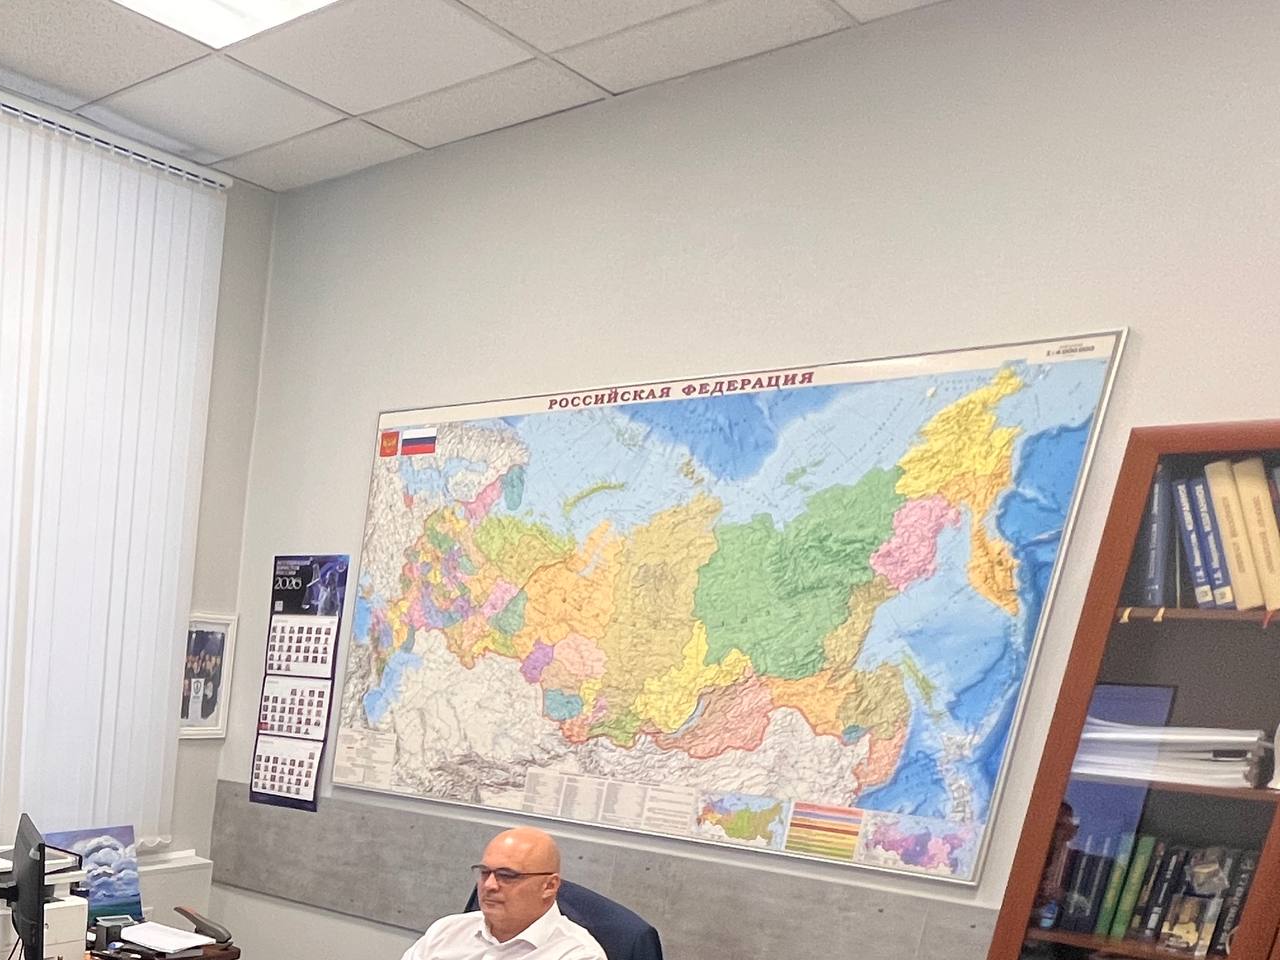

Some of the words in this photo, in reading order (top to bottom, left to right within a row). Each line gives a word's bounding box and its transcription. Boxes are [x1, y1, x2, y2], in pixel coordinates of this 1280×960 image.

[548, 387, 671, 410] РОССИЙСКАЯ
[682, 371, 815, 396] ФЕДЕРАЦИЯ
[274, 577, 302, 590] 2026
